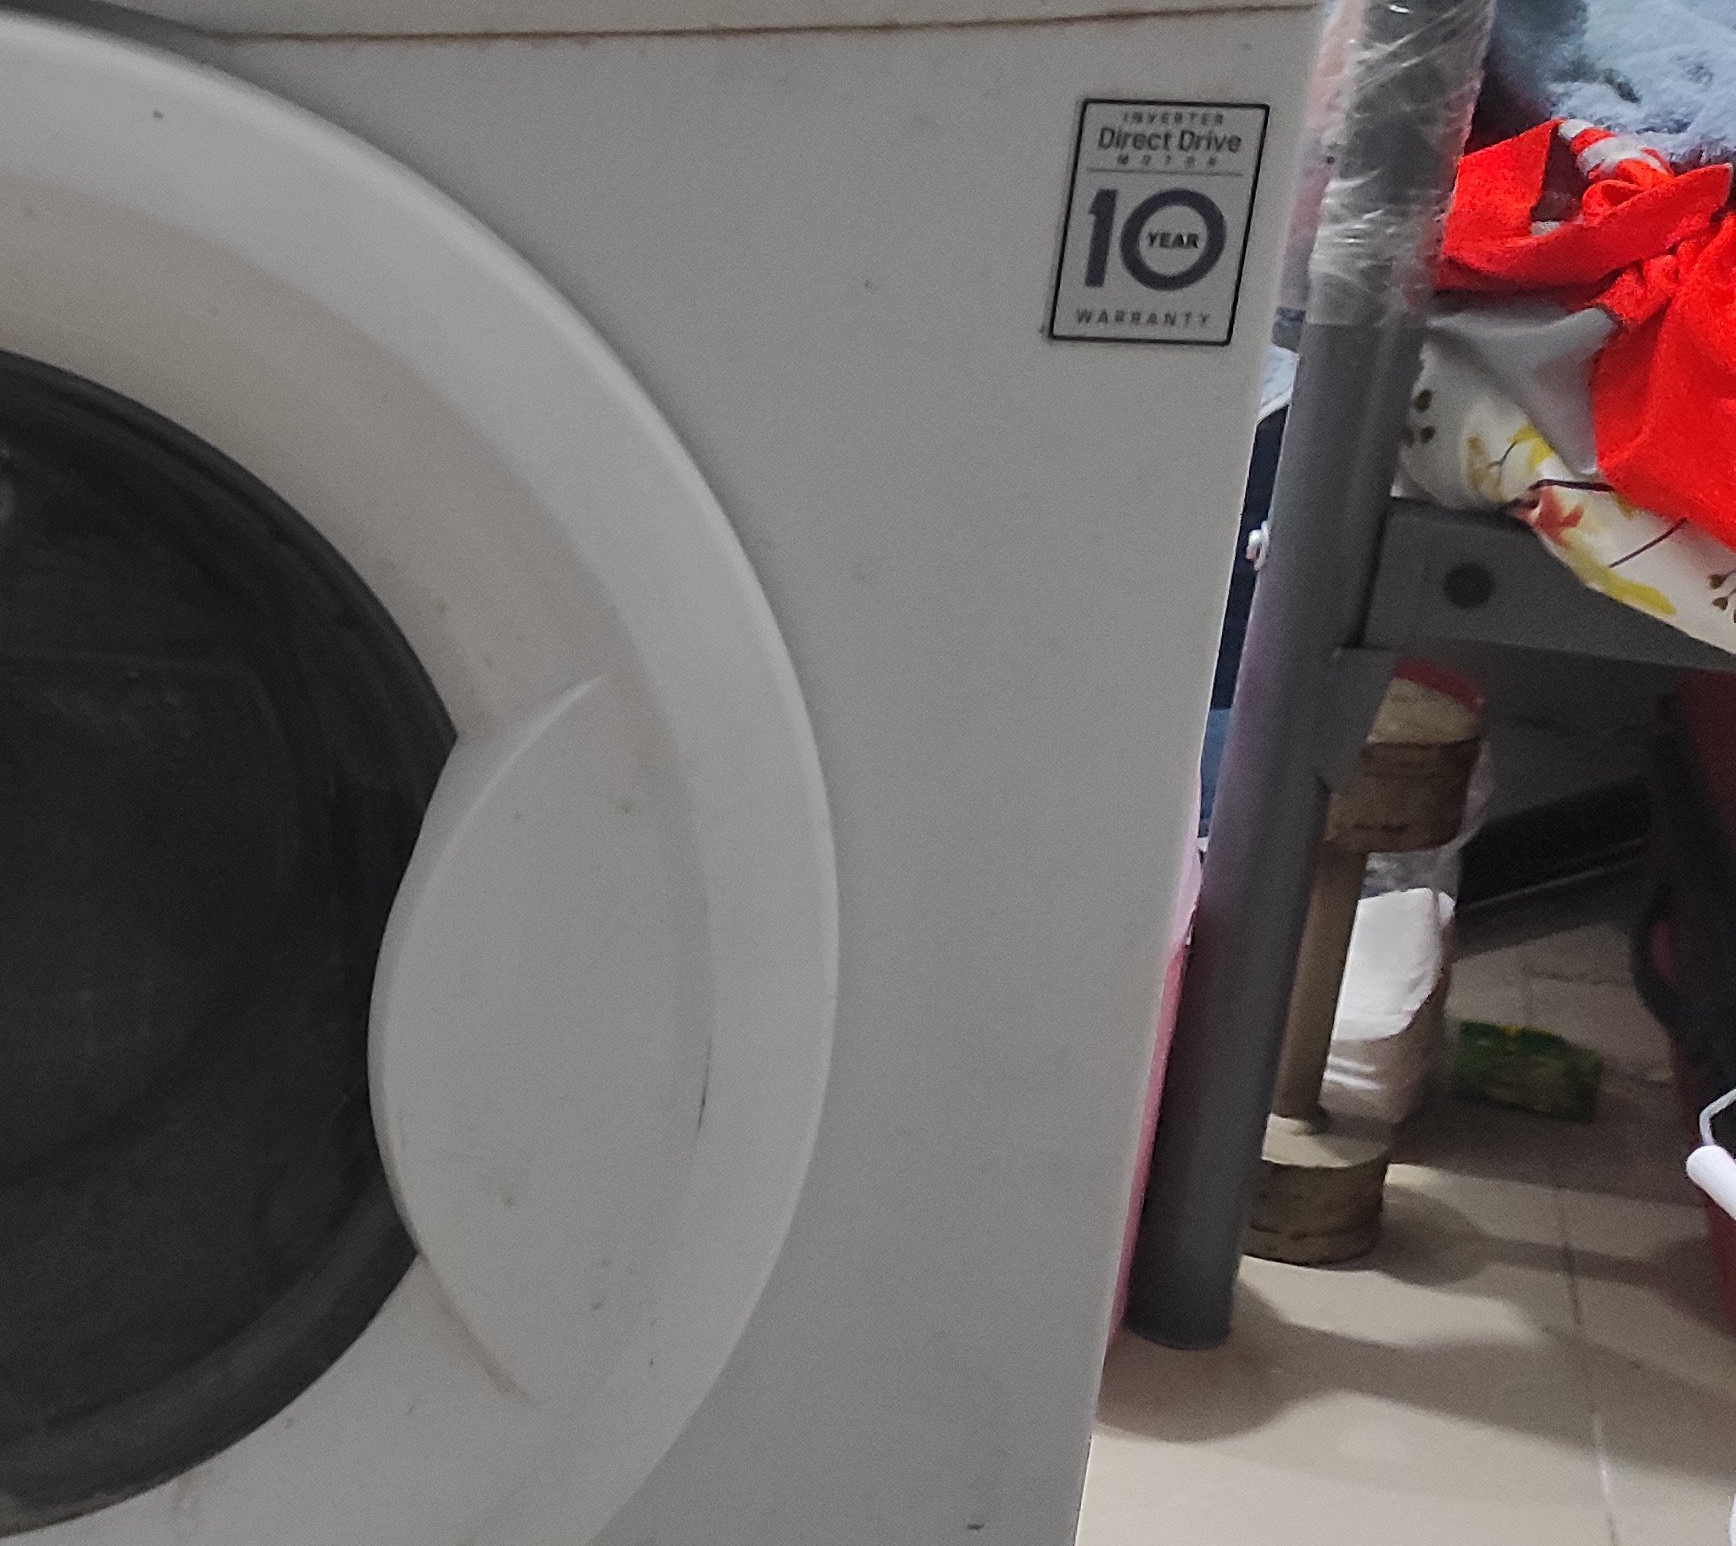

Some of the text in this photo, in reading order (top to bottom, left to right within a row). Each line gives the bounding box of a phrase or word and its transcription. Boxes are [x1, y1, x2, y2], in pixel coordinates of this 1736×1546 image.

[1122, 111, 1225, 126] INVERTER
[1097, 126, 1242, 153] Direct Drive
[1084, 187, 1227, 292] 10
[1147, 230, 1200, 250] YEAR
[1076, 308, 1210, 327] WARRANTY
